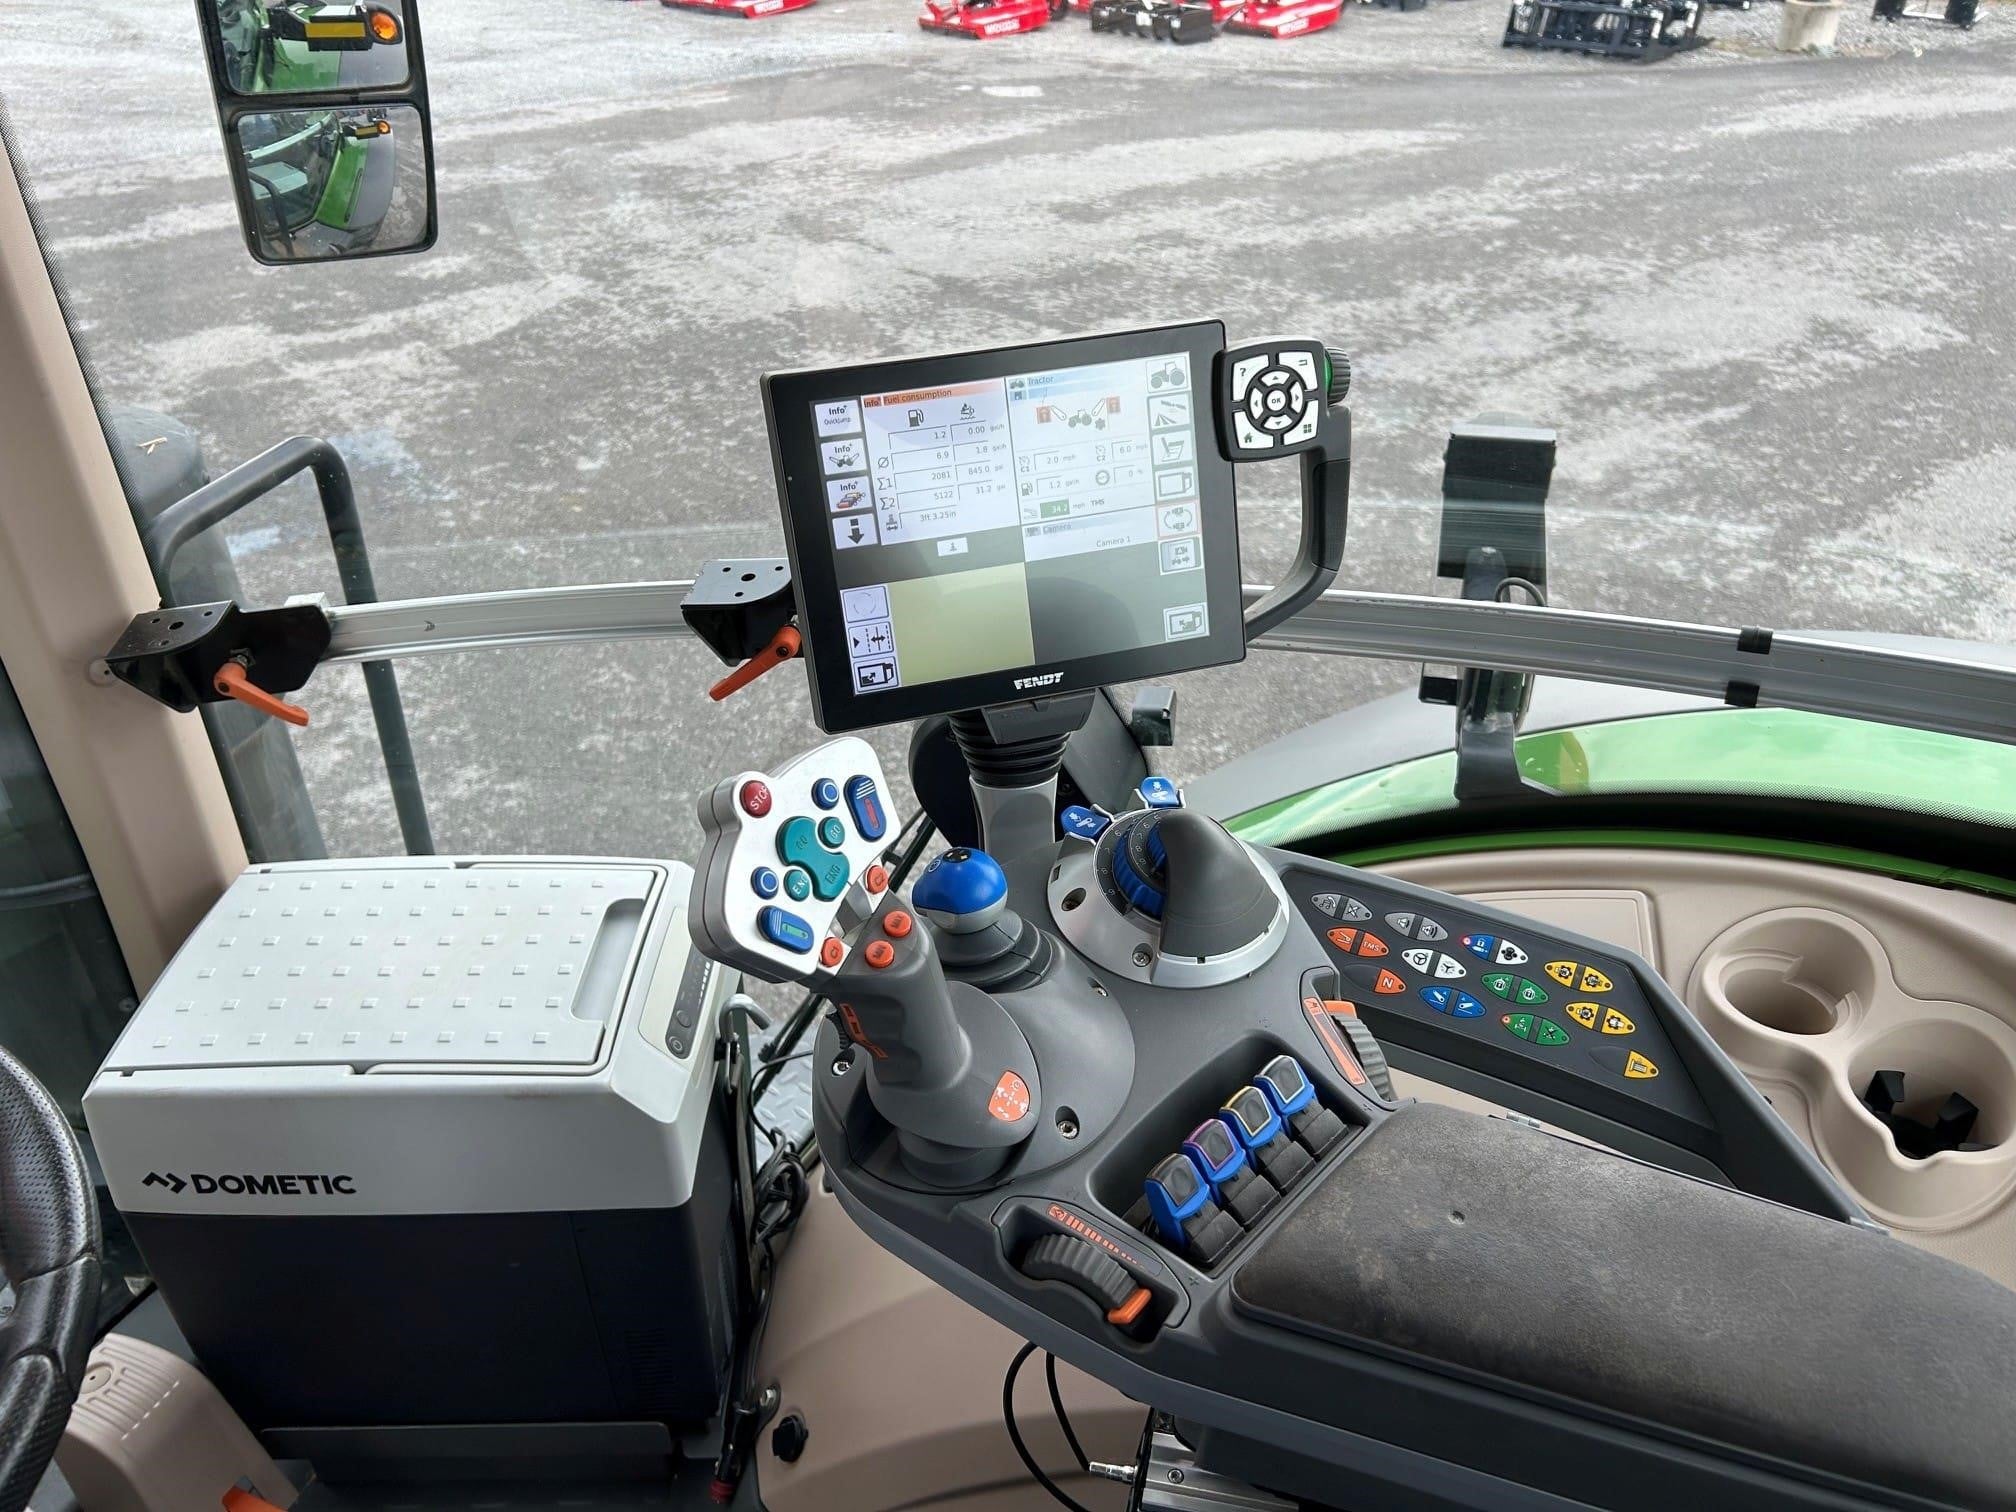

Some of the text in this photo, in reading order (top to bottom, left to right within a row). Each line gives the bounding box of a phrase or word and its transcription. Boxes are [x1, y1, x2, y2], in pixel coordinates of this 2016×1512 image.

[1028, 376, 1054, 385] Tractor
[884, 389, 952, 405] Fuel consumption
[968, 426, 986, 435] 0.00
[1096, 537, 1126, 548] Camera
[1013, 671, 1064, 690] FENDT
[1363, 941, 1380, 952] TMS
[1382, 977, 1394, 988] N
[190, 1173, 357, 1195] DOMETIC
